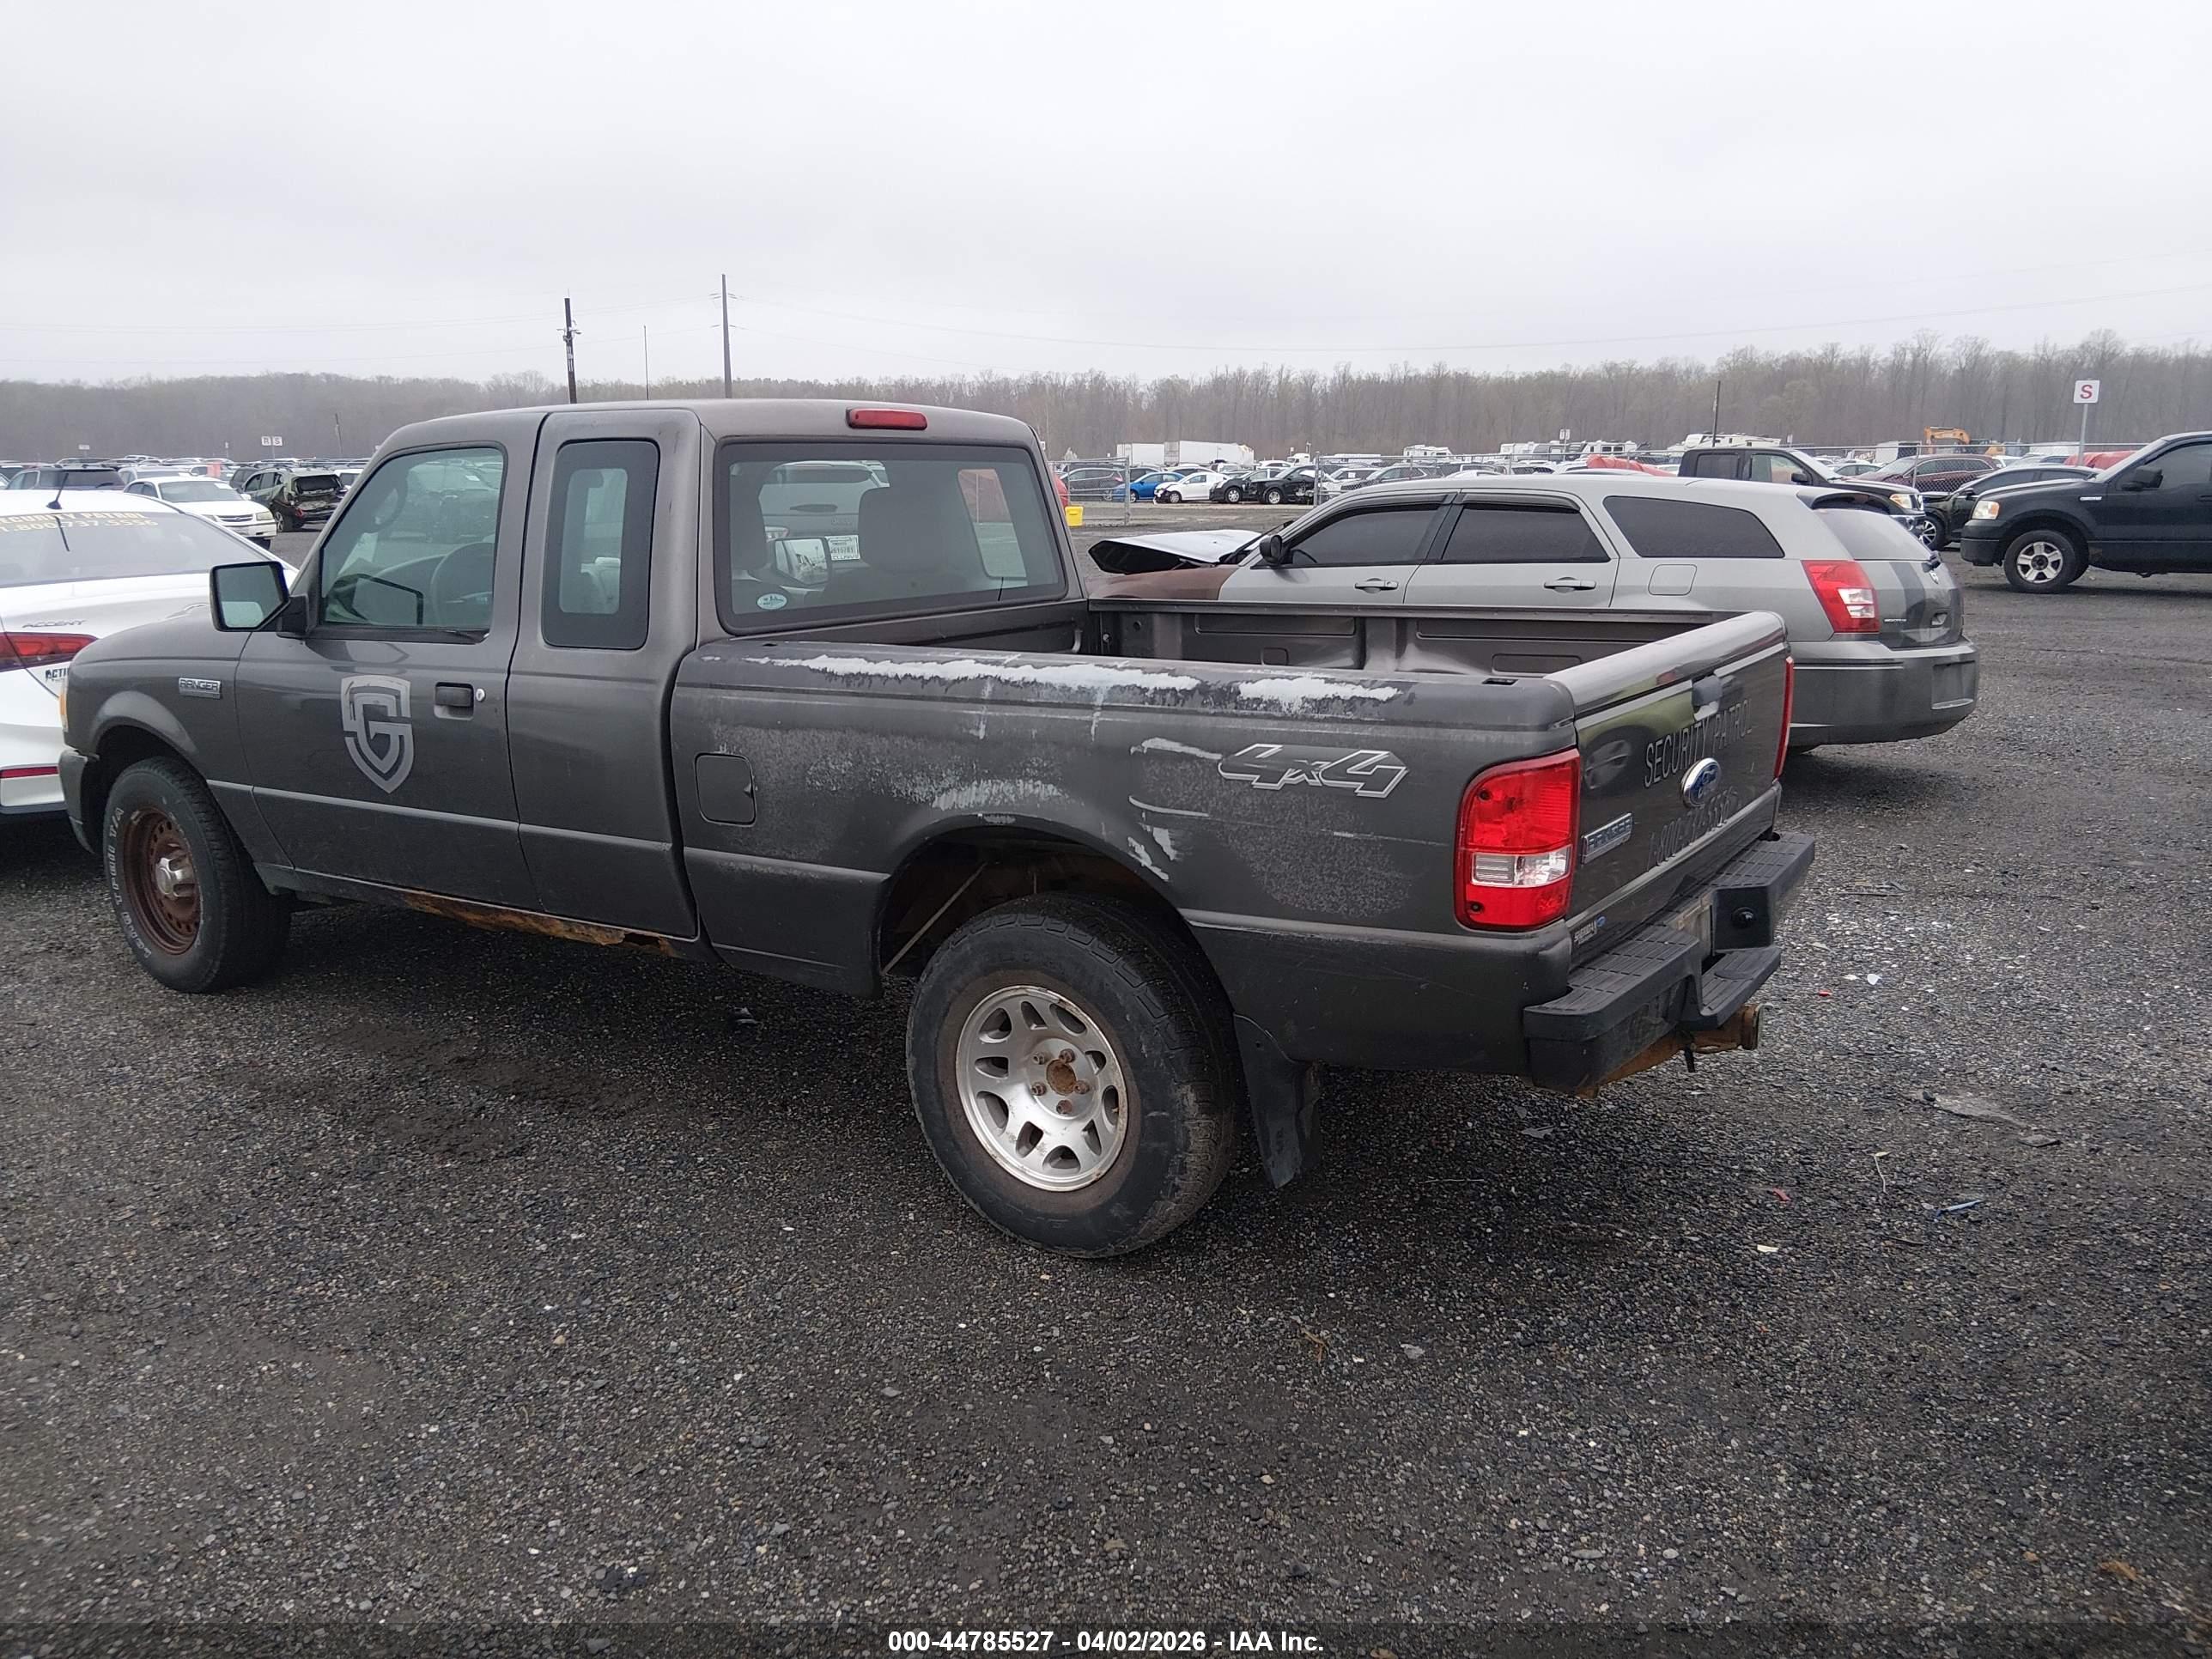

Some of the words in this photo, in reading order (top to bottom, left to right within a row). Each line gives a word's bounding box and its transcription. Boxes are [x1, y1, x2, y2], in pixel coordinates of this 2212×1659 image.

[2080, 384, 2094, 399] S
[0, 513, 76, 524] ECURITY
[21, 619, 88, 629] ACCENT
[46, 667, 70, 679] ACTI
[179, 678, 219, 693] RANGER
[1644, 714, 1710, 788] SECURITY
[1711, 697, 1753, 756] PATROL
[1587, 817, 1632, 854] RANGER
